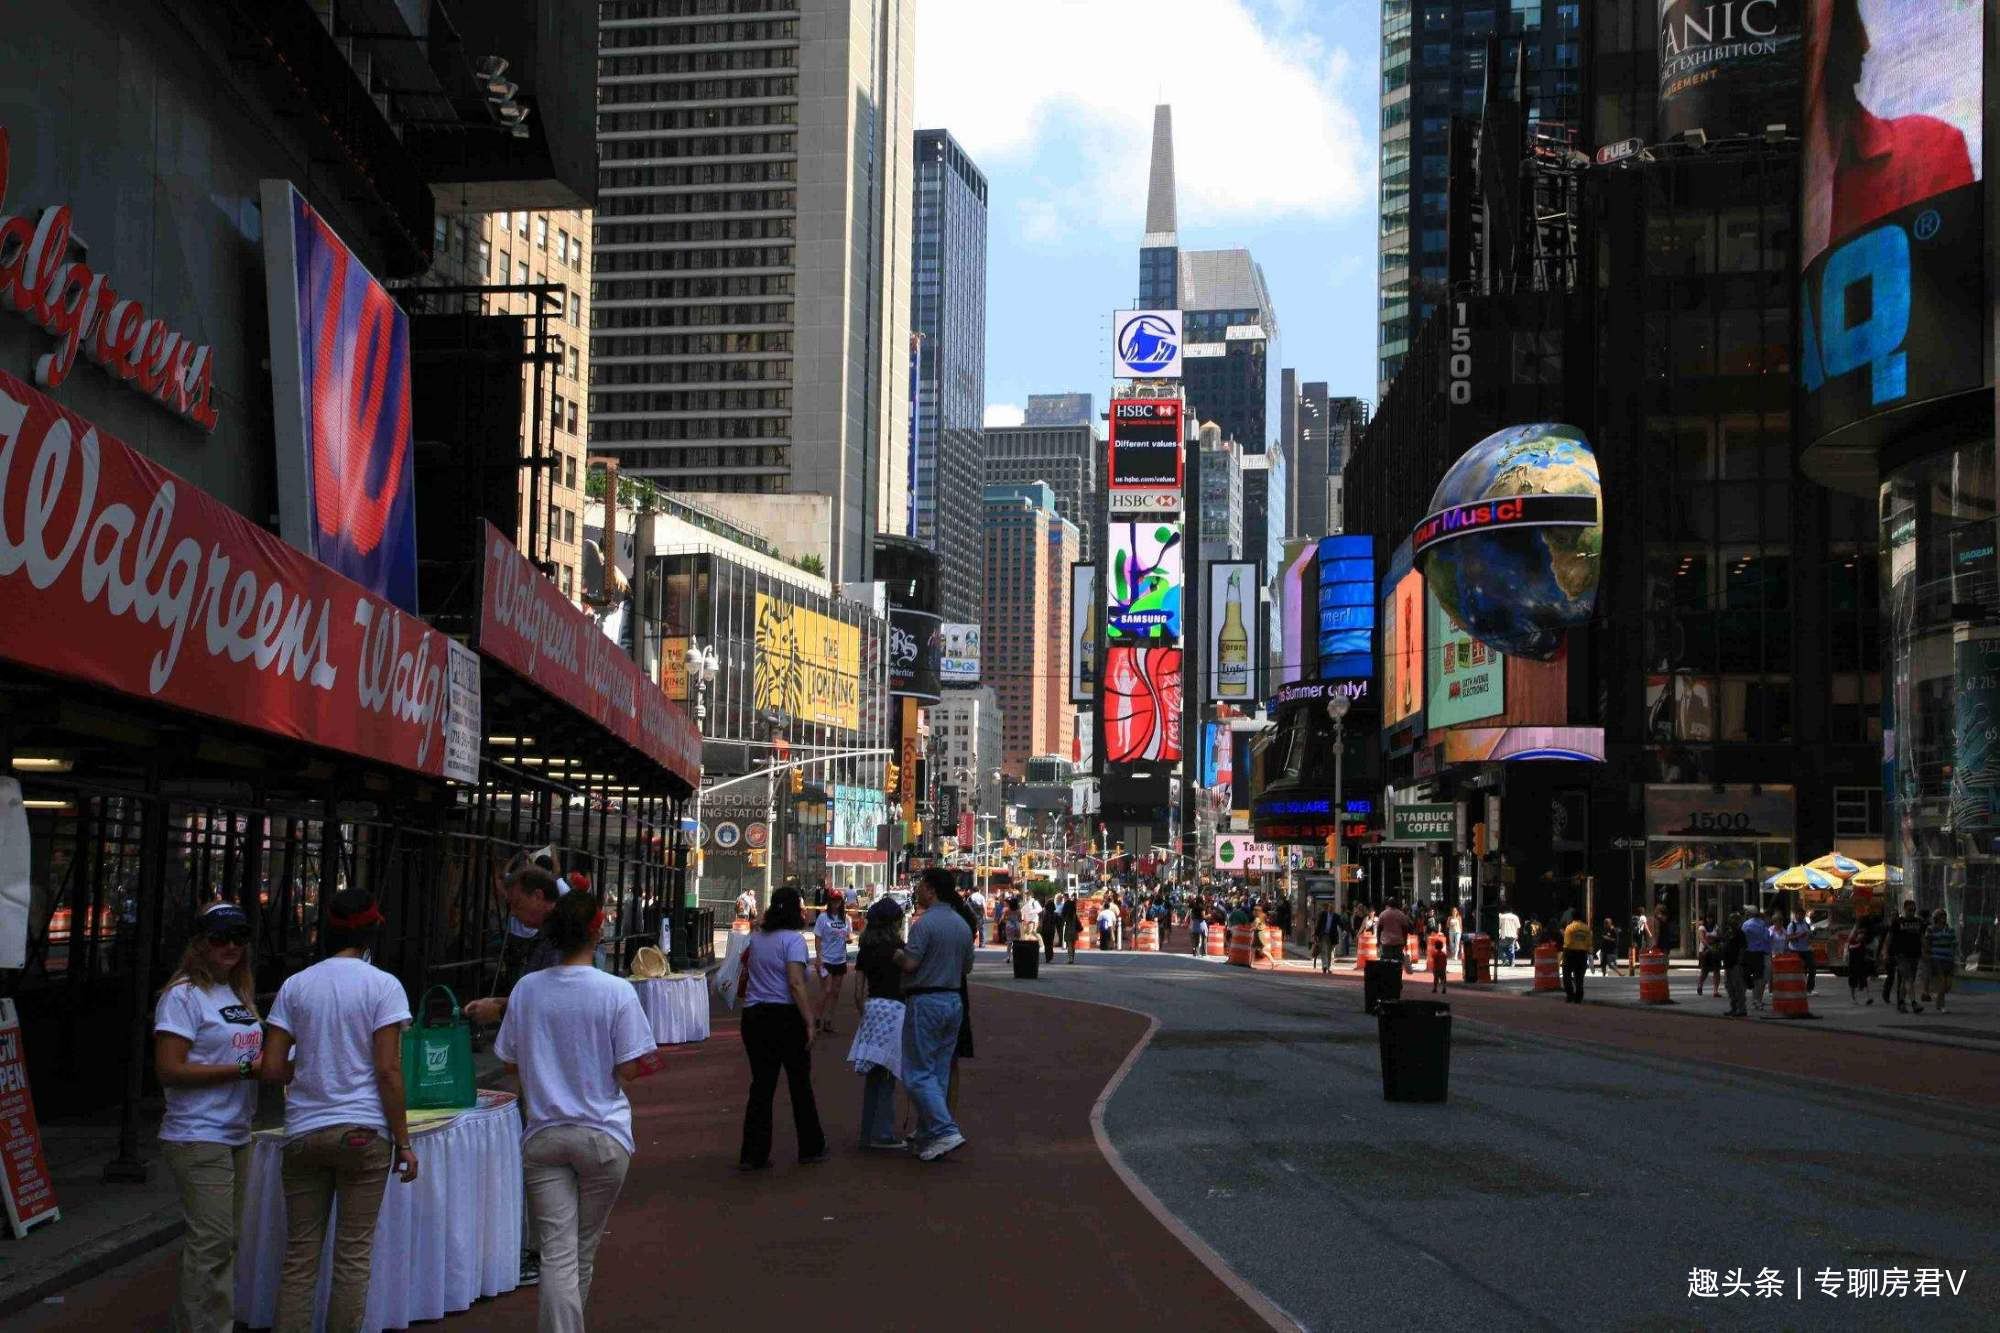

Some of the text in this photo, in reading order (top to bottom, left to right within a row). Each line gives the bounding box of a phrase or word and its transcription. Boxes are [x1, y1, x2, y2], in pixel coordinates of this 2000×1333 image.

[1661, 0, 1777, 65] ANIC
[1680, 40, 1777, 72] EXHIBITION
[1603, 140, 1633, 161] FUEL
[0, 203, 219, 425] algreens
[1450, 302, 1471, 405] 1500
[1116, 405, 1153, 417] HSBC
[1114, 440, 1150, 450] Different
[1112, 494, 1154, 508] HSBC
[1442, 497, 1524, 532] Music!
[0, 390, 337, 694] Walgreens
[1120, 614, 1168, 624] SAMSUNG
[667, 649, 683, 657] THE
[1285, 685, 1325, 701] Summer
[1327, 680, 1368, 700] only!
[903, 737, 915, 806] Kodak
[1395, 811, 1454, 822] STARBUCK
[1688, 811, 1750, 830] 1500
[1407, 823, 1450, 832] COFFEE
